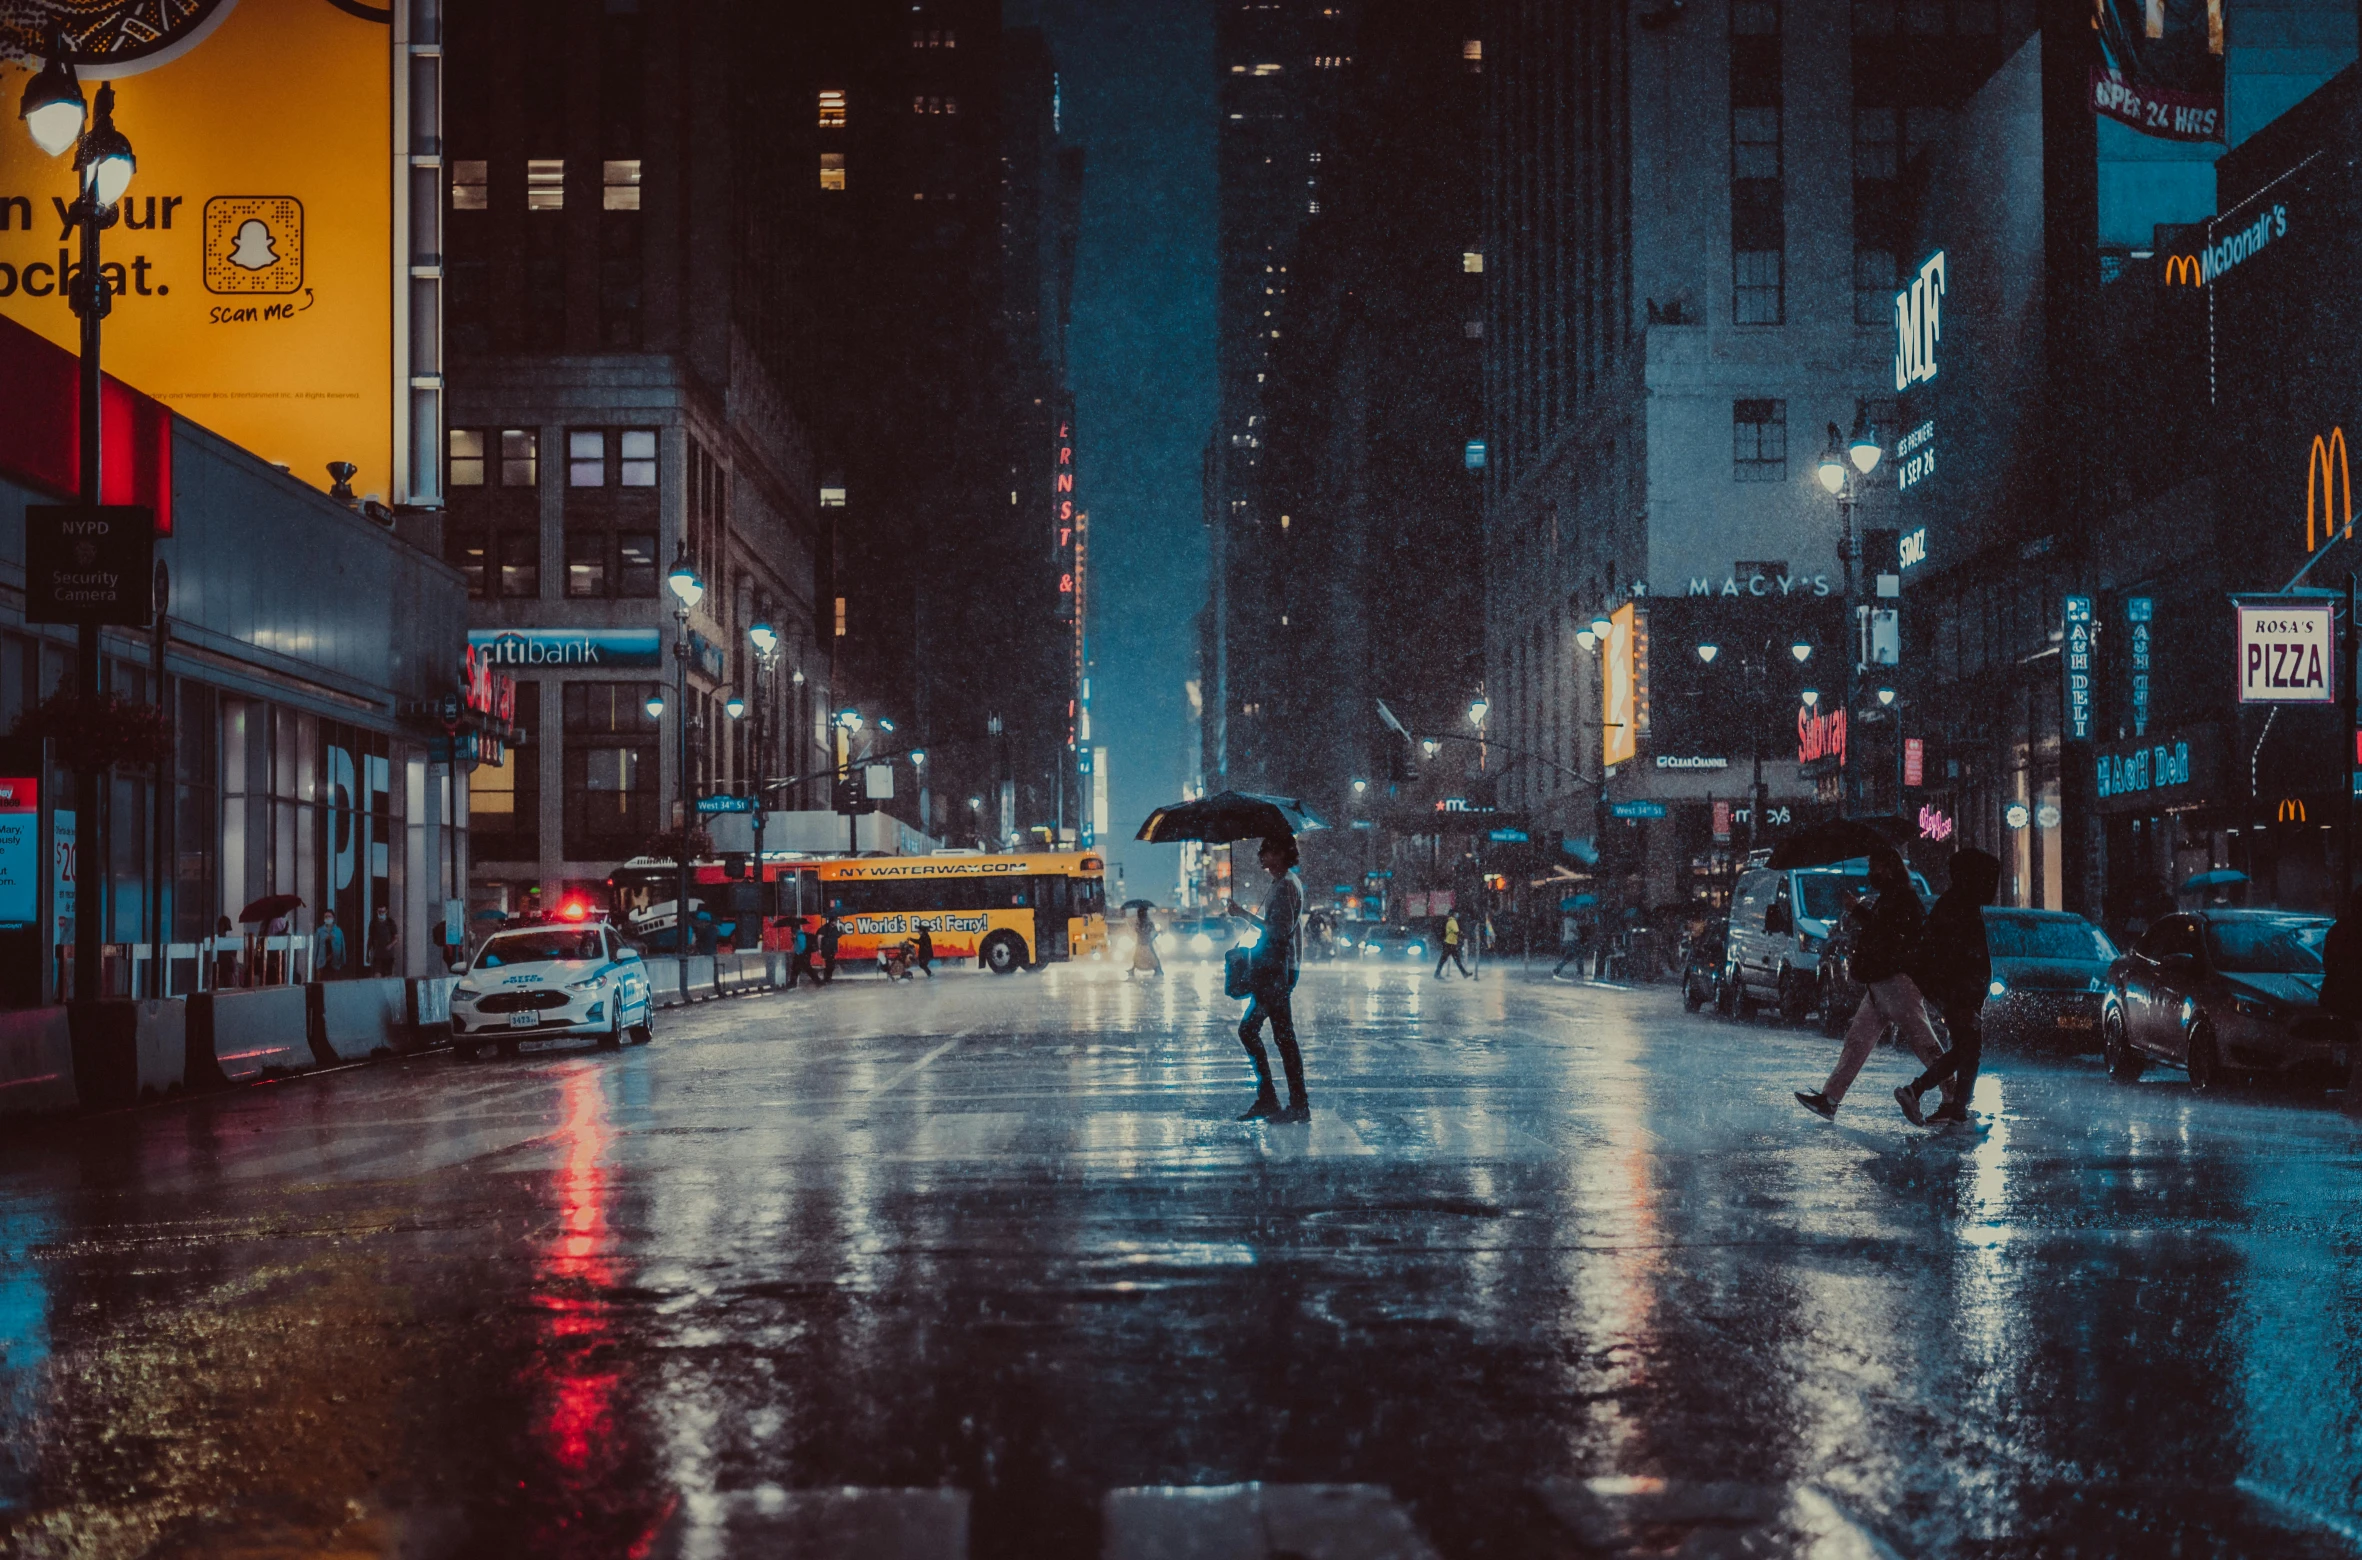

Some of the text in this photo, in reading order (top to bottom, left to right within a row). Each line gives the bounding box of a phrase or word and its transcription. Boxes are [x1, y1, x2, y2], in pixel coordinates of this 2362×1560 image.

[2175, 106, 2217, 134] HRS
[209, 303, 295, 324] scan me
[1907, 456, 1922, 486] SEP
[1923, 448, 1935, 476] 26
[62, 521, 109, 534] NYPD
[53, 571, 118, 587] Security
[54, 587, 116, 601] Camera
[2255, 620, 2314, 634] ROSA'S
[477, 637, 600, 664] citibank
[2248, 643, 2324, 688] PIZZA
[2154, 741, 2189, 788] Deli
[698, 801, 718, 810] West
[736, 801, 745, 809] St
[1616, 807, 1637, 815] West
[839, 867, 868, 878] NY
[836, 913, 989, 934] he World's Best Ferry!
